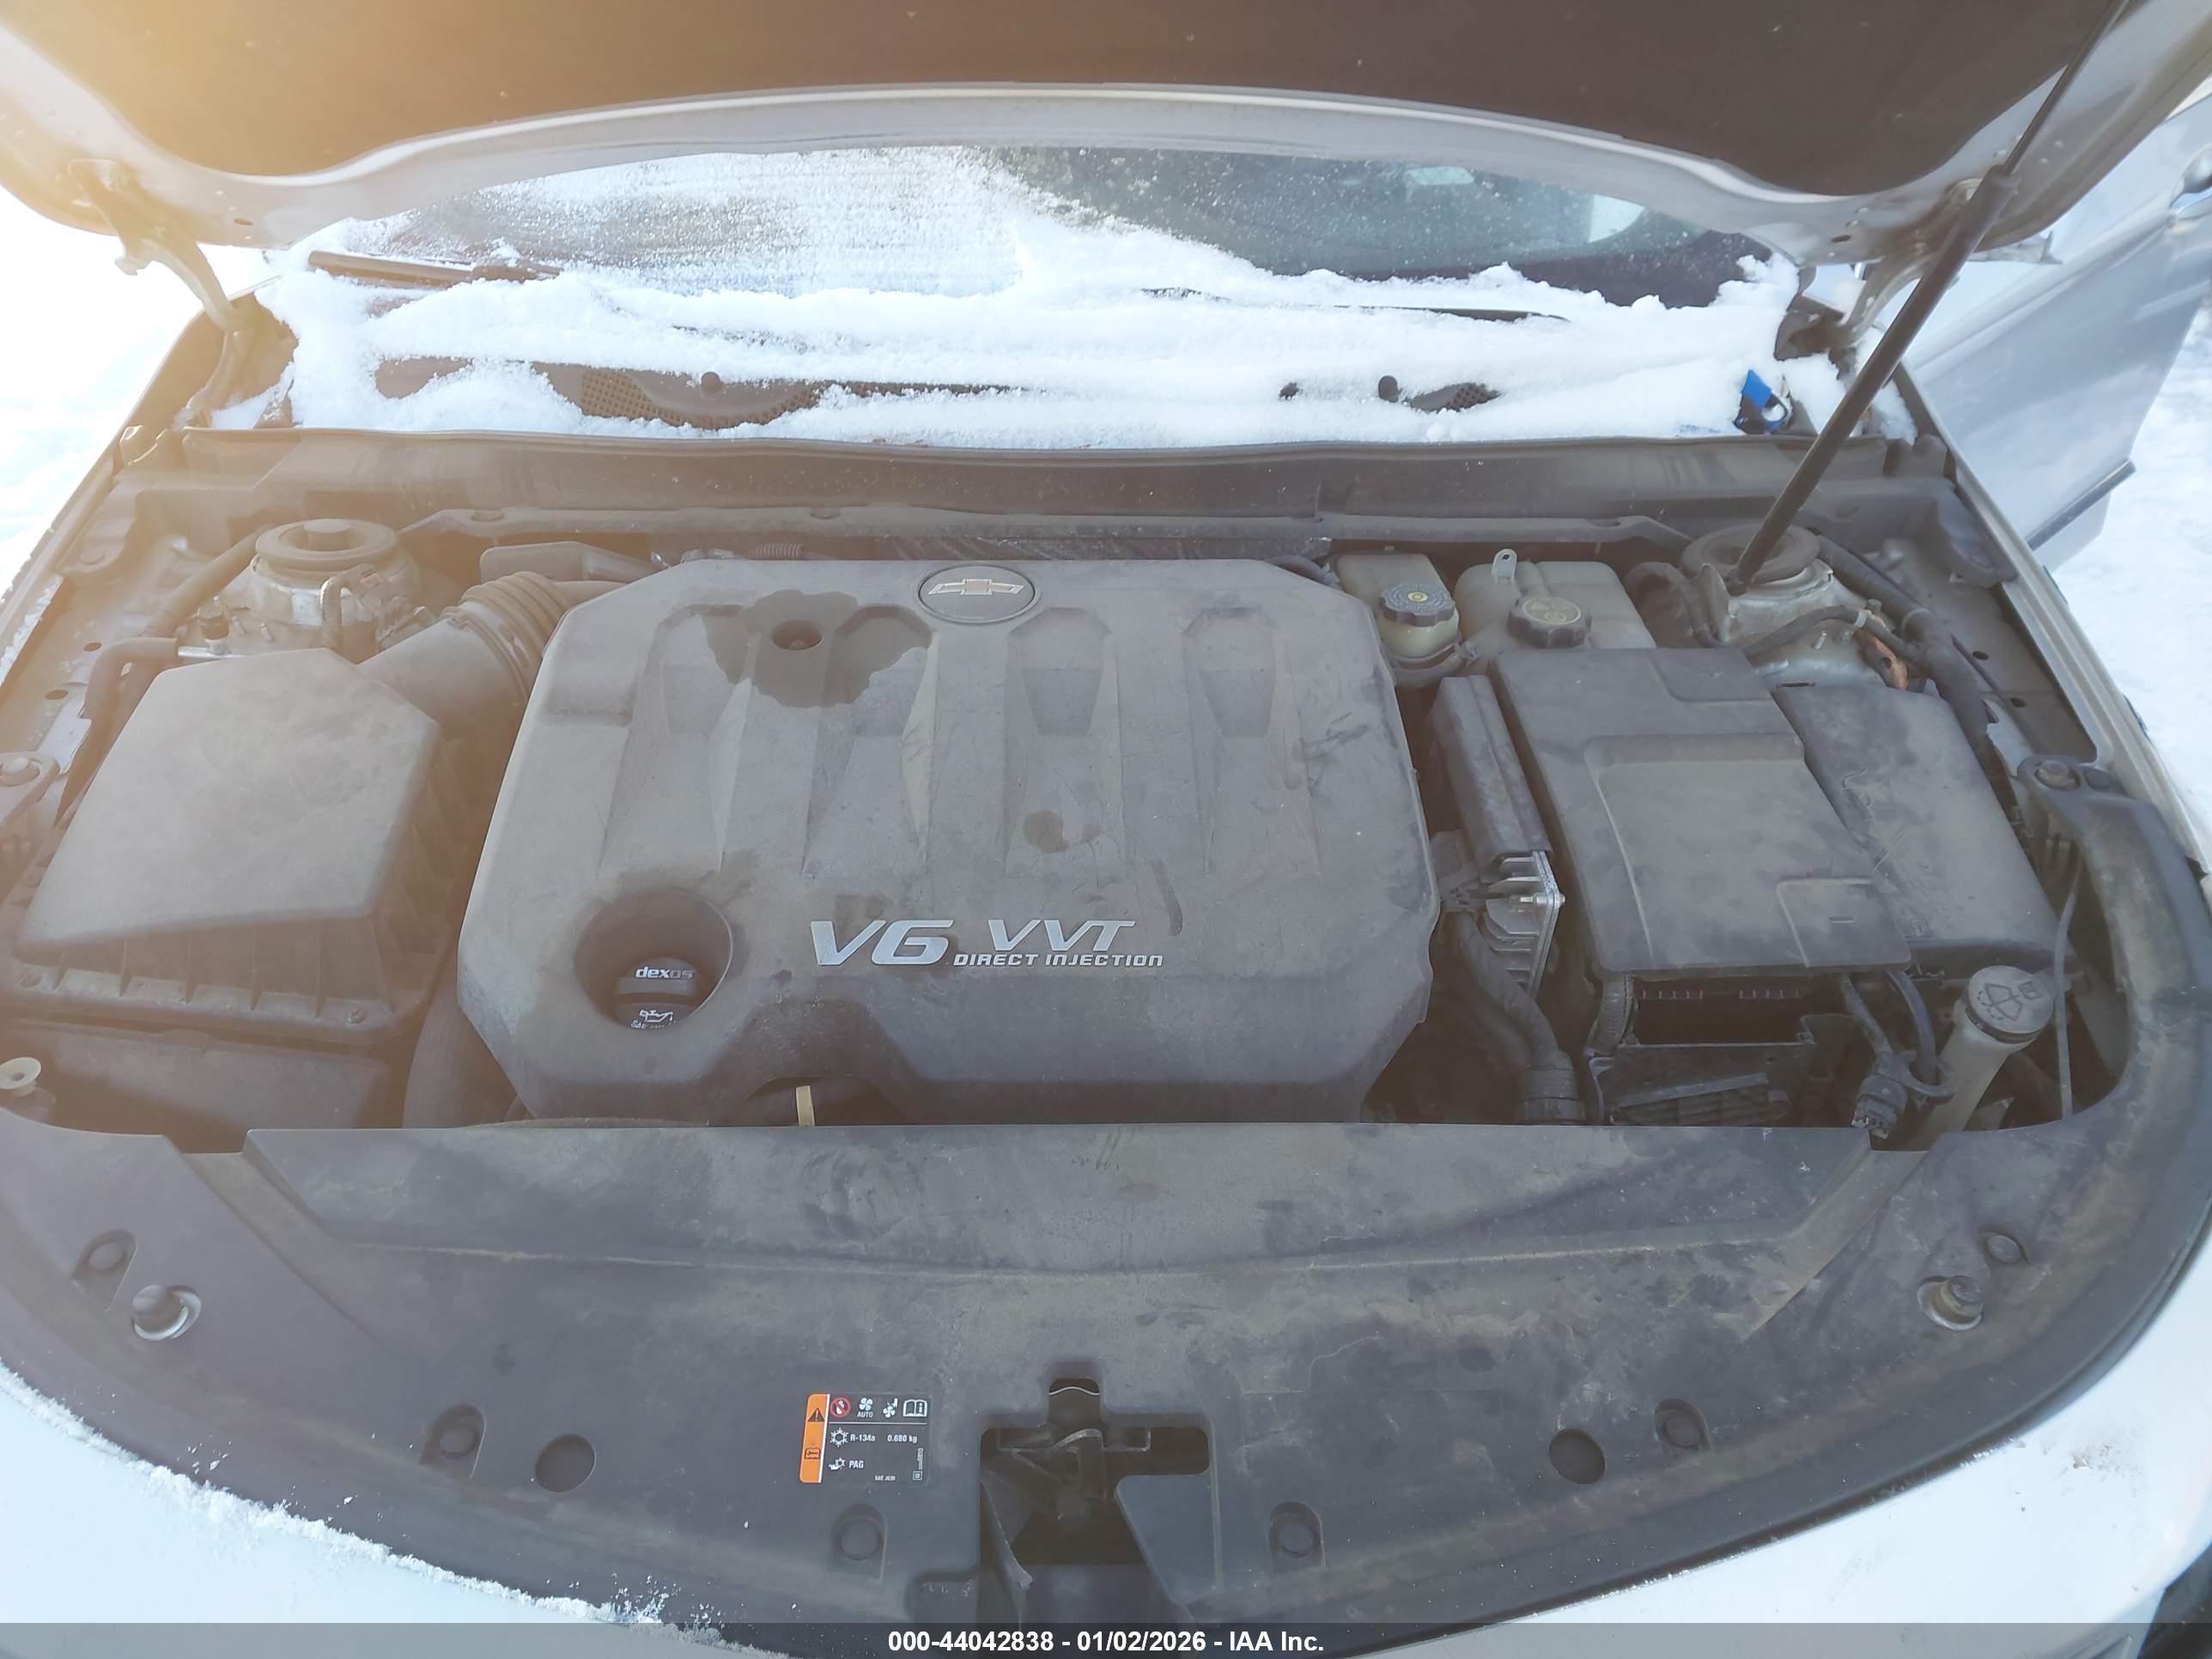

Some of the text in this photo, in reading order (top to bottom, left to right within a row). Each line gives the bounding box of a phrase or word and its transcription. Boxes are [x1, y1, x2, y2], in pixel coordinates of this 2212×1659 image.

[810, 919, 1136, 966] V6 VVT
[952, 953, 1164, 968] DIRECT INJECTION
[635, 966, 696, 980] dexos
[850, 1433, 918, 1443] R-134a 0.680 kg
[848, 1460, 865, 1469] PAG
